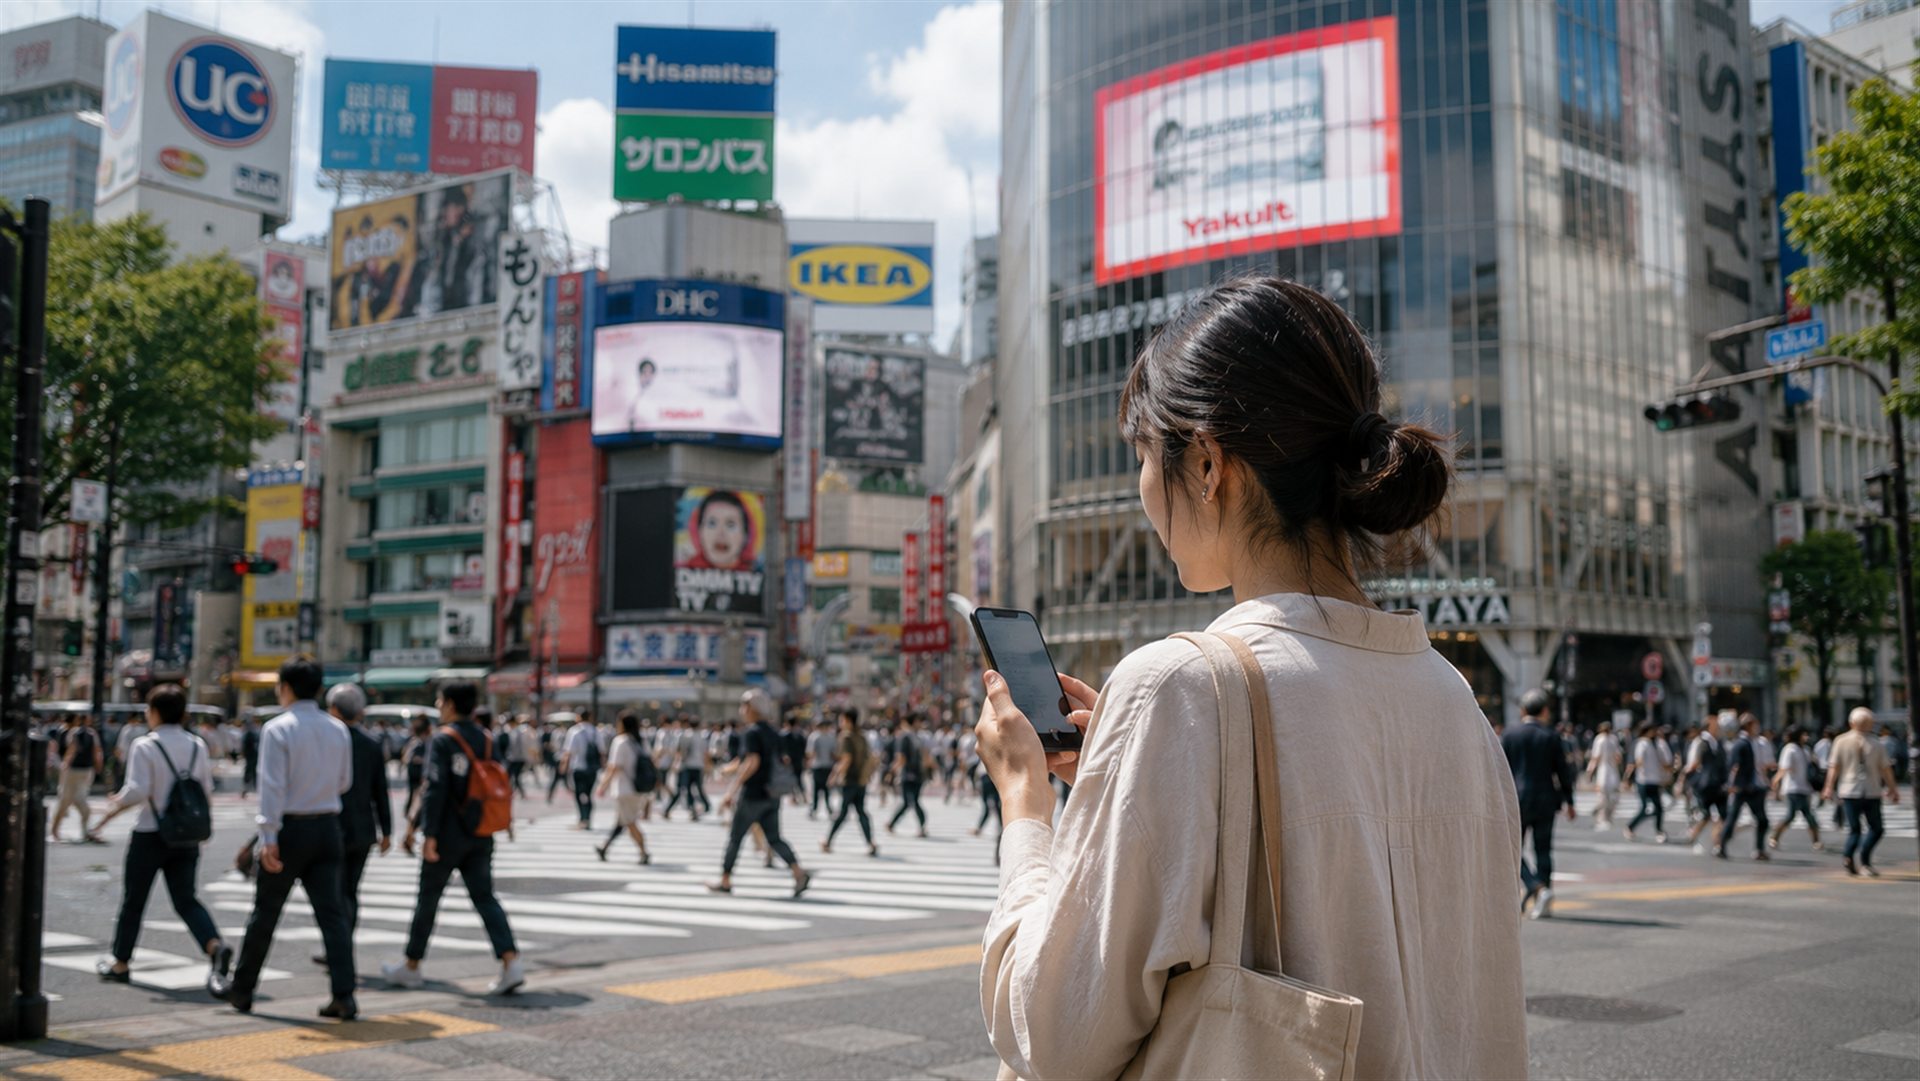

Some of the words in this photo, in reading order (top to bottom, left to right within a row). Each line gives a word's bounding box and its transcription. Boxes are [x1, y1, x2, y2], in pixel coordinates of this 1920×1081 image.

[617, 52, 774, 85] Hisamitsu
[179, 55, 266, 125] UC
[1182, 200, 1294, 238] Yakult
[800, 262, 915, 287] IKEA
[656, 288, 719, 317] DHC
